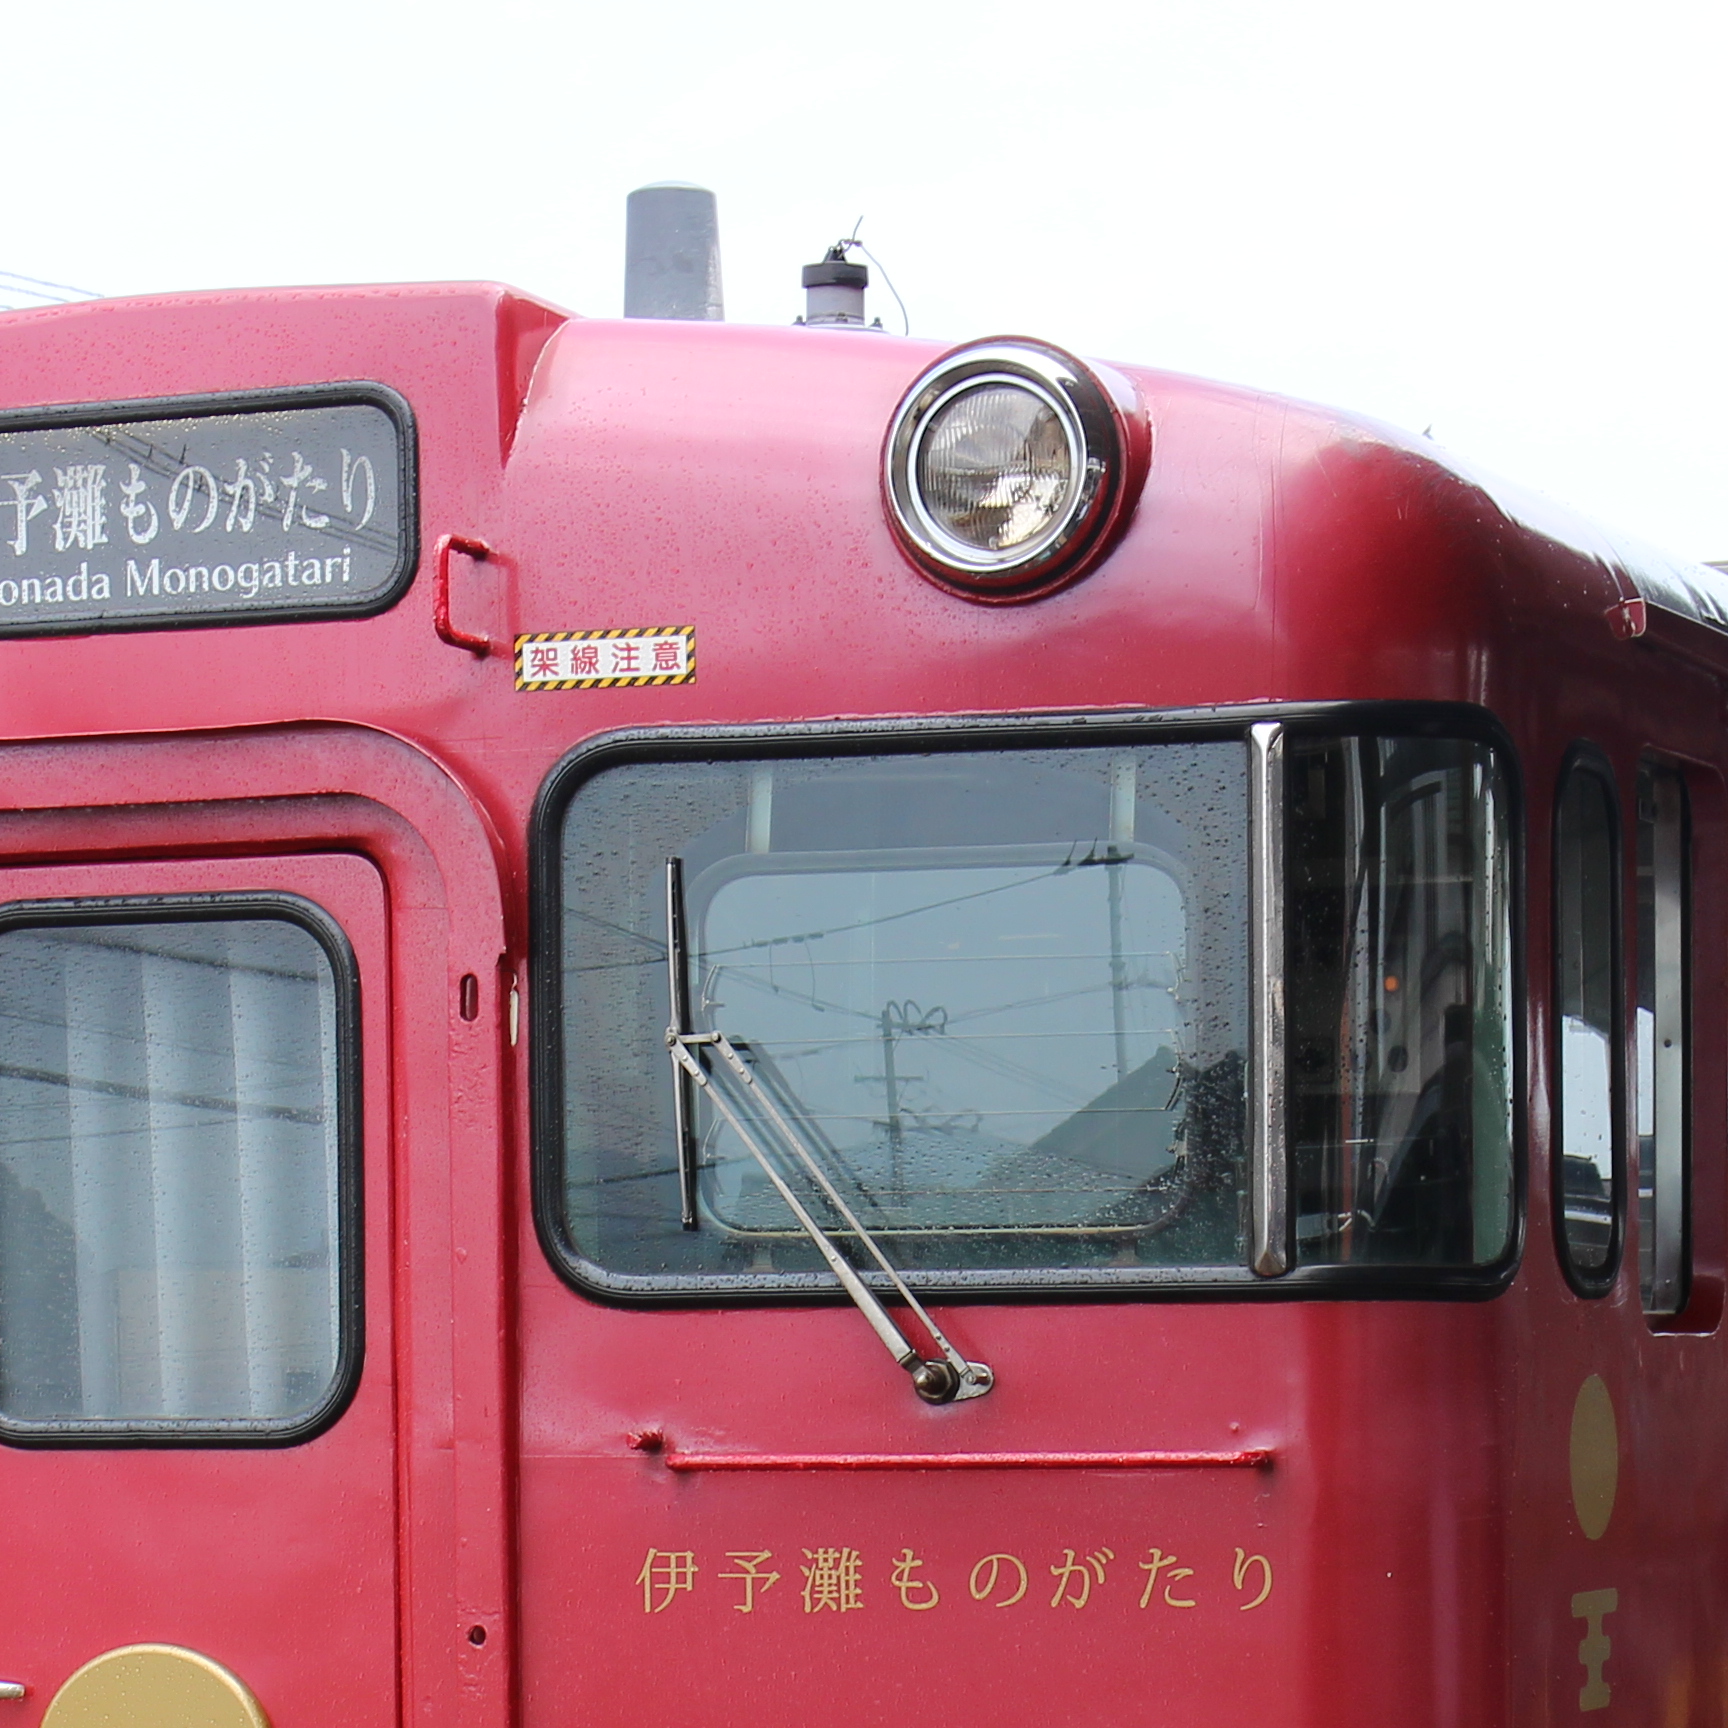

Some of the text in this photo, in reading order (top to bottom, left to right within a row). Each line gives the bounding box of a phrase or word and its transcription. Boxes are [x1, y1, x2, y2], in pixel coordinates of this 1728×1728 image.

[125, 544, 353, 600] Monogatari
[529, 639, 682, 679] 架線注意
[635, 1546, 1274, 1614] 伊予灘ものがたり
